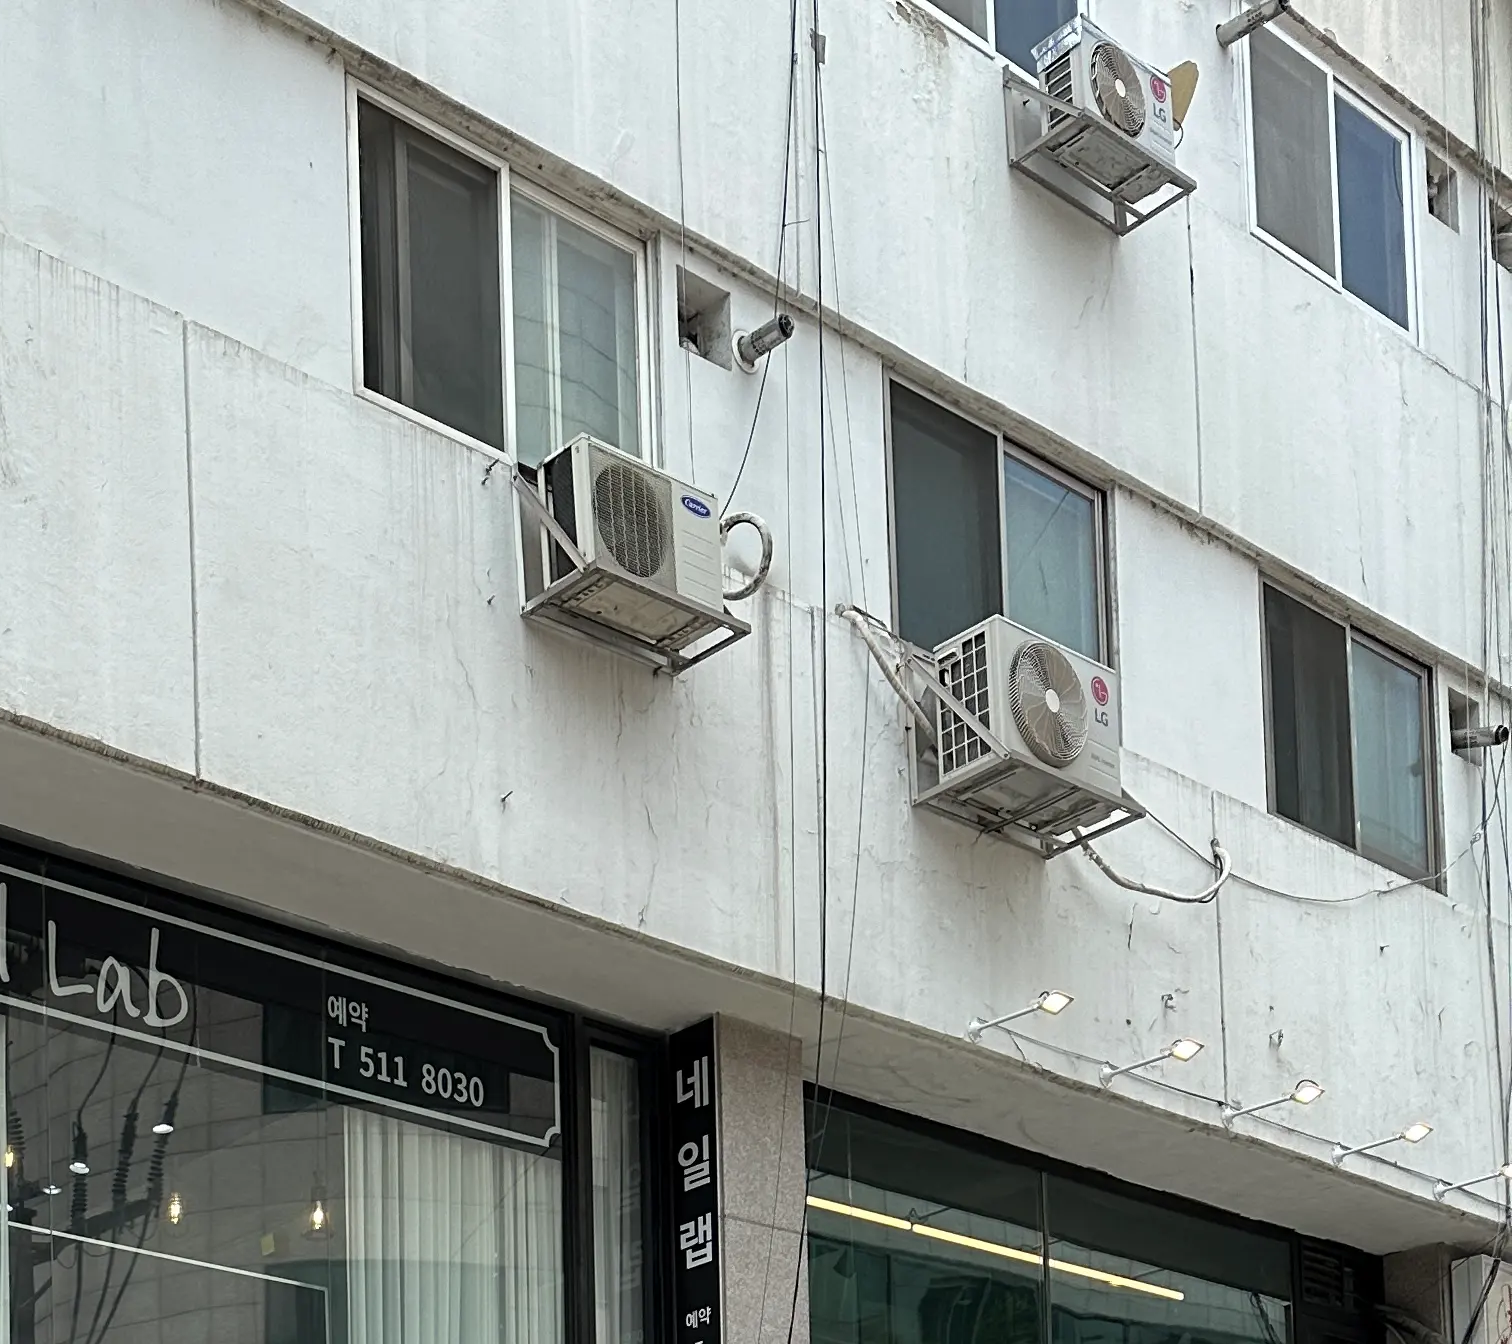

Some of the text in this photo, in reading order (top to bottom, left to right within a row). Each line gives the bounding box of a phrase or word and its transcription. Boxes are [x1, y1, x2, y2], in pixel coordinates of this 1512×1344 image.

[1152, 102, 1167, 123] LG
[1094, 707, 1109, 728] LG
[46, 920, 190, 1028] Lab
[327, 995, 370, 1034] 예약
[326, 1037, 485, 1108] T 511 8030
[676, 1055, 714, 1271] 네일랩
[685, 1305, 713, 1329] 예약
